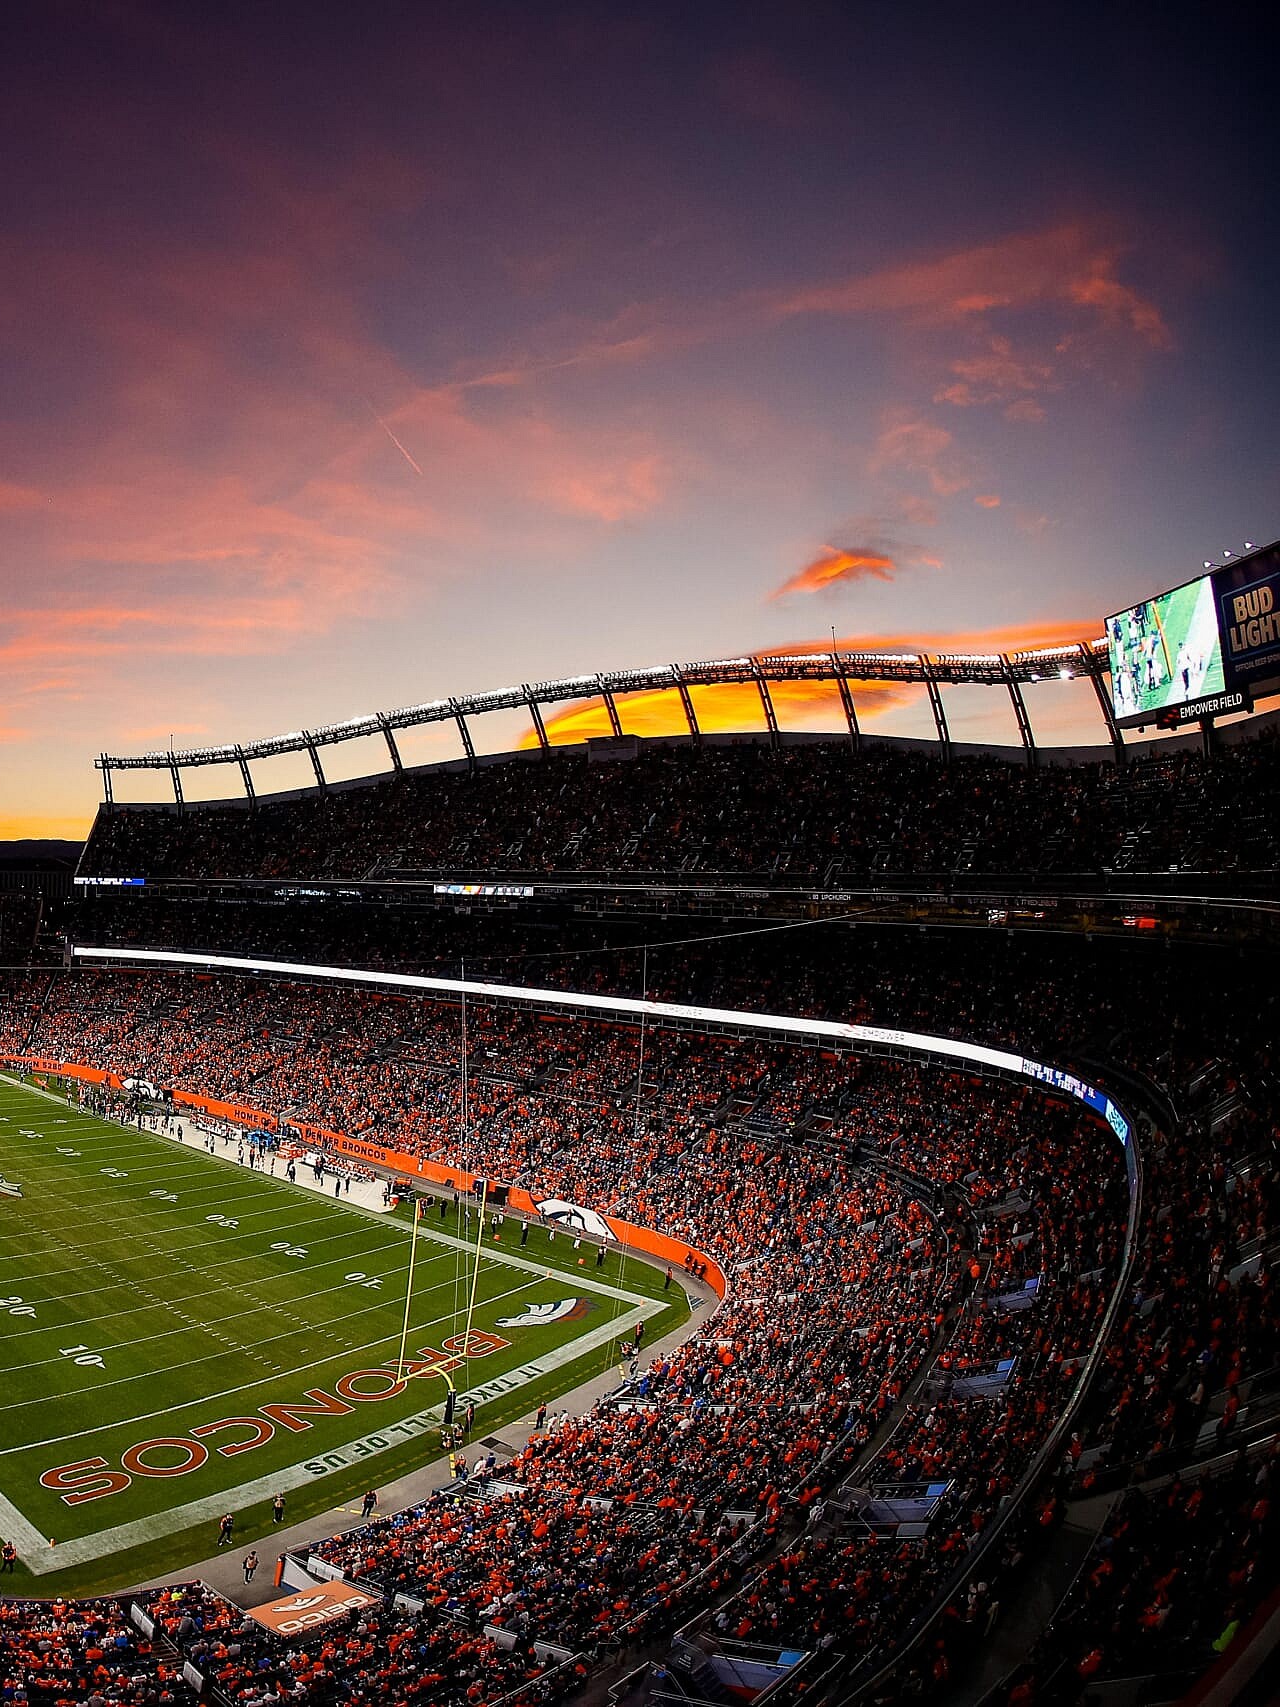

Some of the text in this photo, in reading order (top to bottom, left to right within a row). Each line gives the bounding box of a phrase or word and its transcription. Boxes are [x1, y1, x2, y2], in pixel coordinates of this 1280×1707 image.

[1232, 586, 1274, 623] BUD
[1230, 611, 1280, 652] LIGHT
[1180, 693, 1242, 718] EMPOWER FIELD
[862, 1028, 906, 1042] EMPOWER
[234, 1110, 258, 1122] HOME
[342, 1141, 386, 1161] BRONCOS
[205, 1214, 240, 1230] 30
[270, 1242, 309, 1259] 20
[345, 1272, 384, 1290] 10
[58, 1344, 103, 1367] 10
[39, 1328, 512, 1506] BRONCOS
[304, 1365, 544, 1475] IT TAKES ALL OF US
[276, 1596, 368, 1632] GEICO
